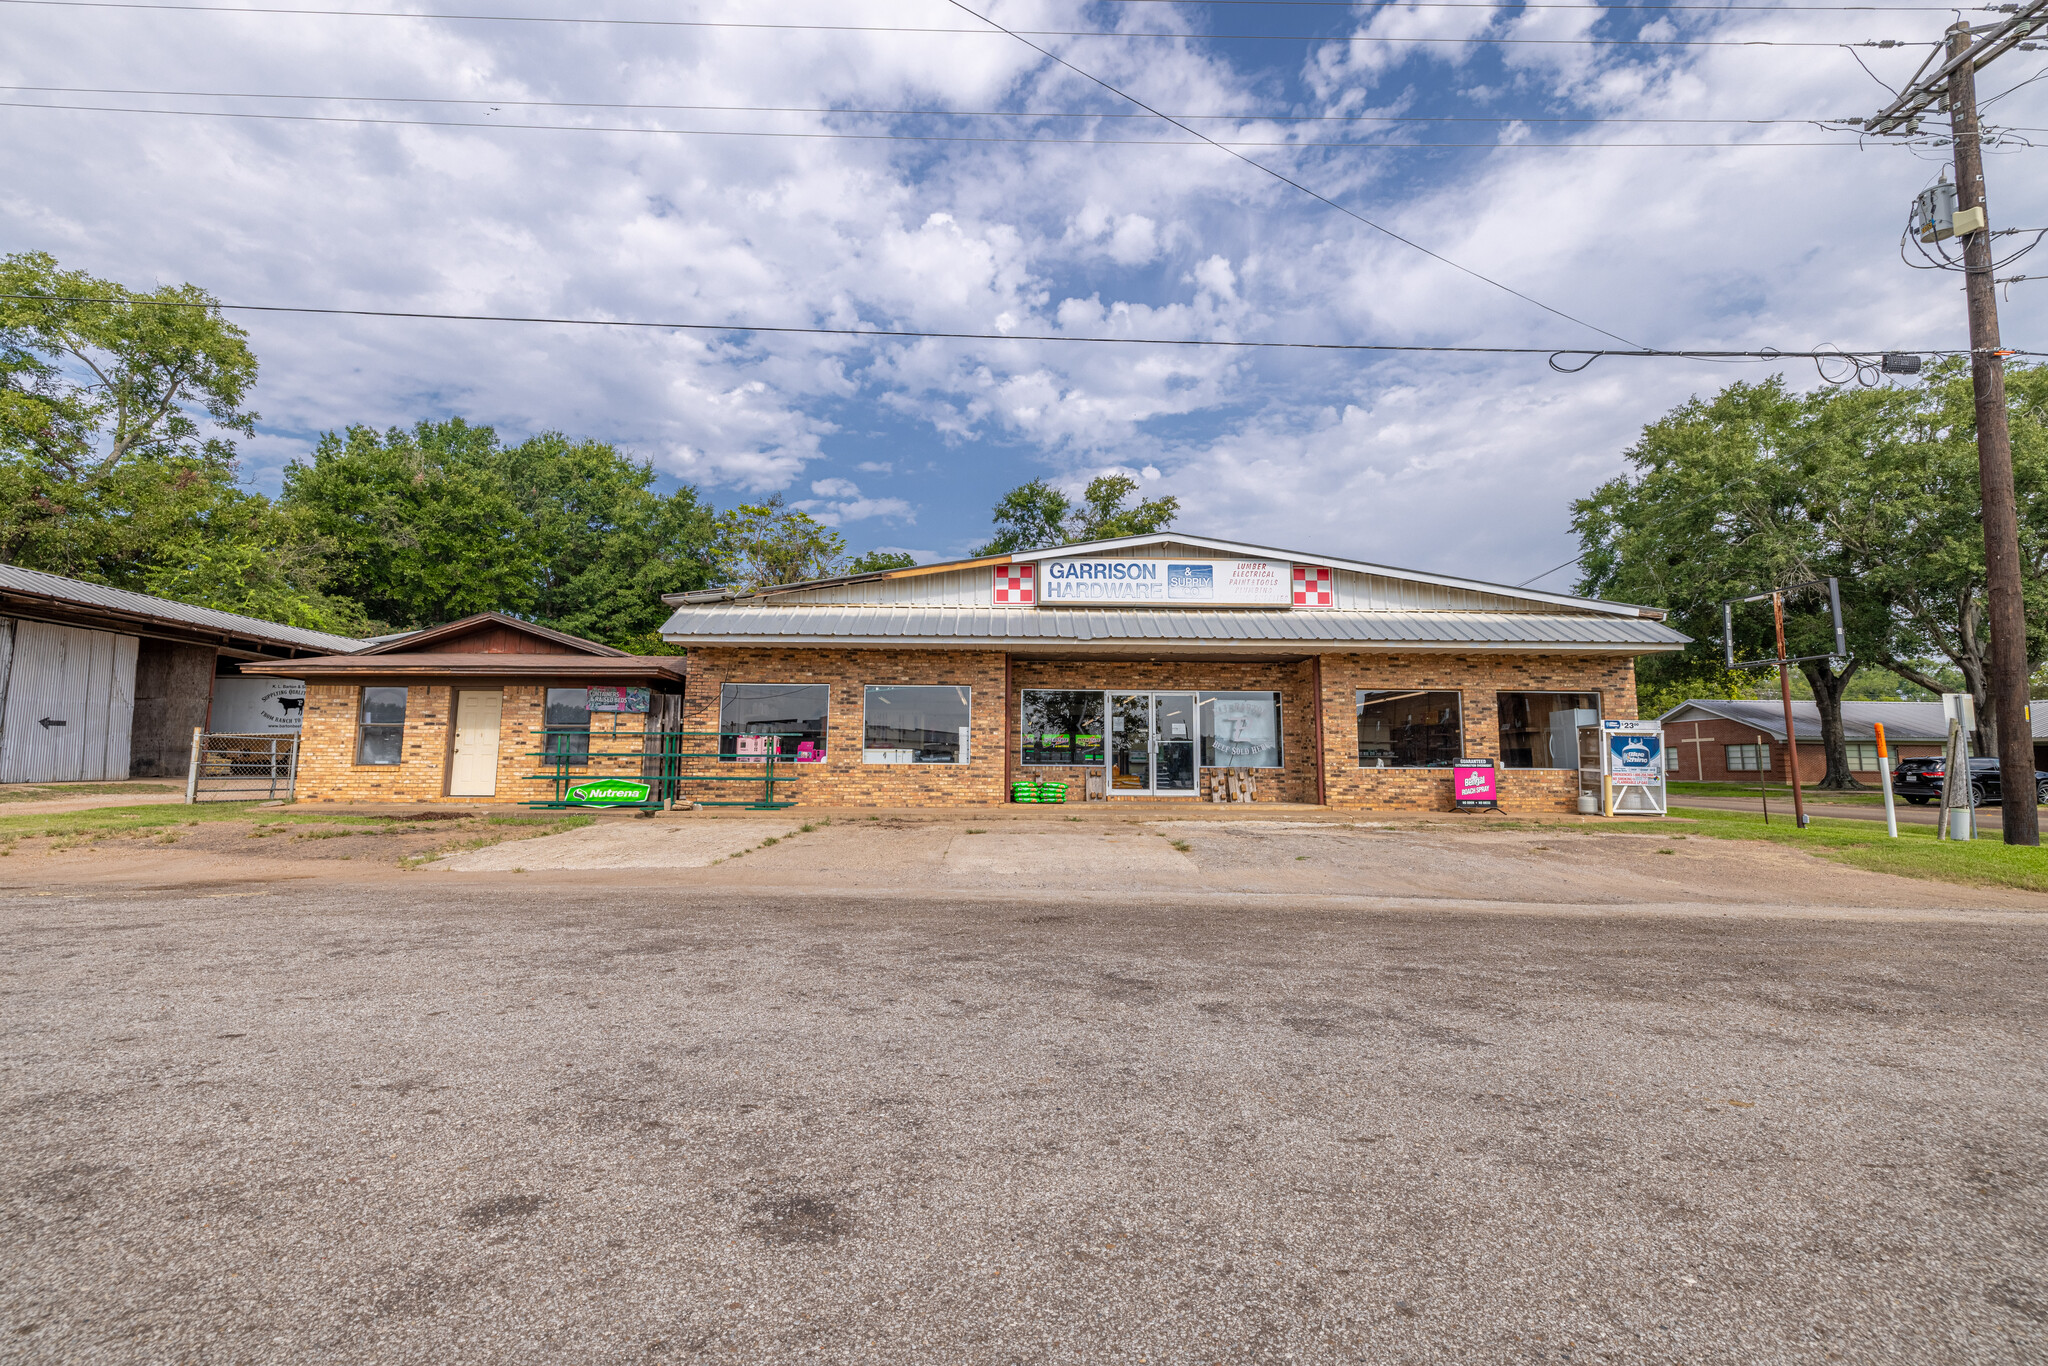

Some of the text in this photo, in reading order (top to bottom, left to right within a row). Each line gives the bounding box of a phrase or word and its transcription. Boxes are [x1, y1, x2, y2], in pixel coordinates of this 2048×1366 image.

[1050, 562, 1157, 580] GARRISON
[1184, 566, 1193, 577] &
[1237, 562, 1268, 570] LUMBER
[1232, 570, 1276, 578] ELECTRICAL
[1170, 577, 1211, 588] SUPPLY
[1048, 581, 1163, 599] HARDWARE
[261, 690, 288, 702] SUPPLYING
[1212, 740, 1231, 753] BEEF
[1231, 747, 1250, 755] SOLD
[1464, 776, 1486, 786] Bengal
[589, 788, 640, 798] Nutrena
[1462, 786, 1490, 796] ROACH SPRAY
